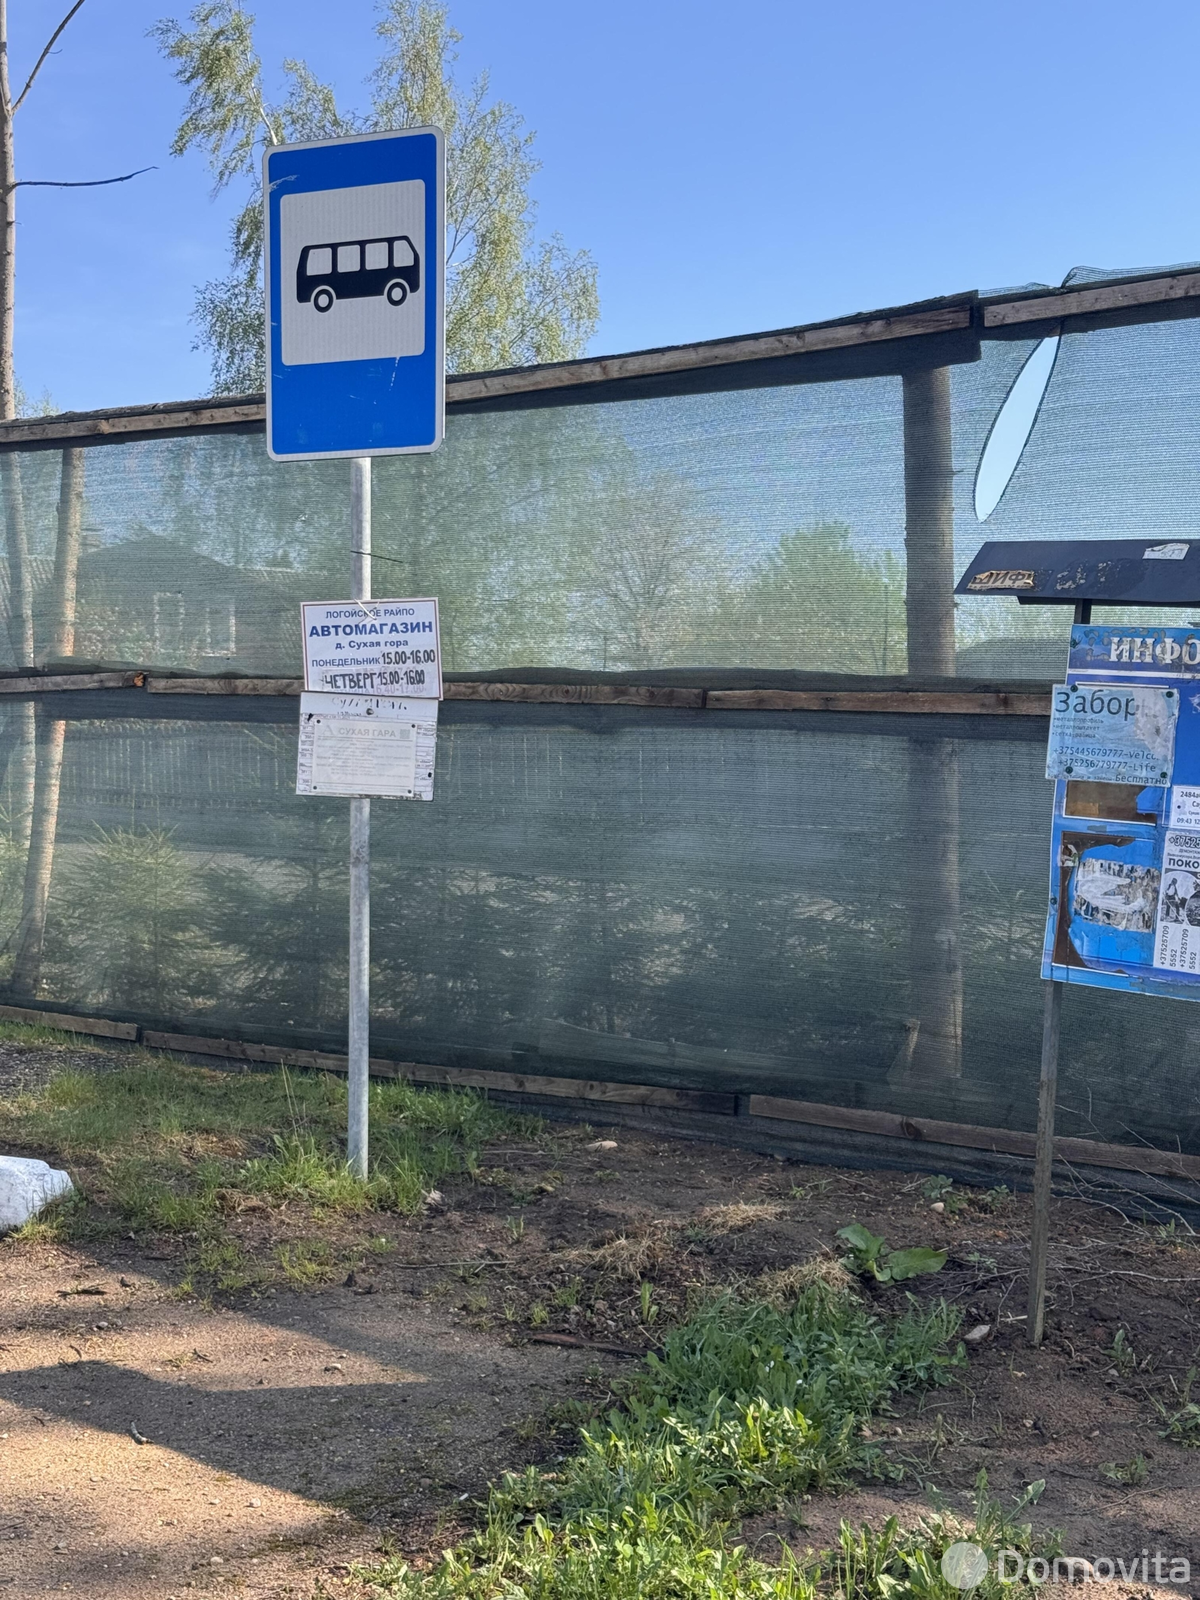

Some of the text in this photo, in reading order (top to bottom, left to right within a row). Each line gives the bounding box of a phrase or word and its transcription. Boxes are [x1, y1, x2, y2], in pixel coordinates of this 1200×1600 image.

[326, 607, 415, 619] ЛОГОЙСКОЕ РАЙПО
[309, 621, 433, 637] АВТОМАГАЗИН
[348, 640, 381, 650] Сухая
[384, 639, 408, 649] гора
[312, 649, 436, 667] ПОНЕДЕЛЬНИК 15.00-16.00
[324, 672, 378, 689] ЧЕТВЕРГ
[339, 728, 370, 737] СУХАЯ
[372, 729, 397, 738] ГАРА
[1160, 925, 1170, 966] +37525709
[1180, 928, 1189, 968] +37525709
[1169, 948, 1178, 968] 5552
[1189, 951, 1197, 970] 5552
